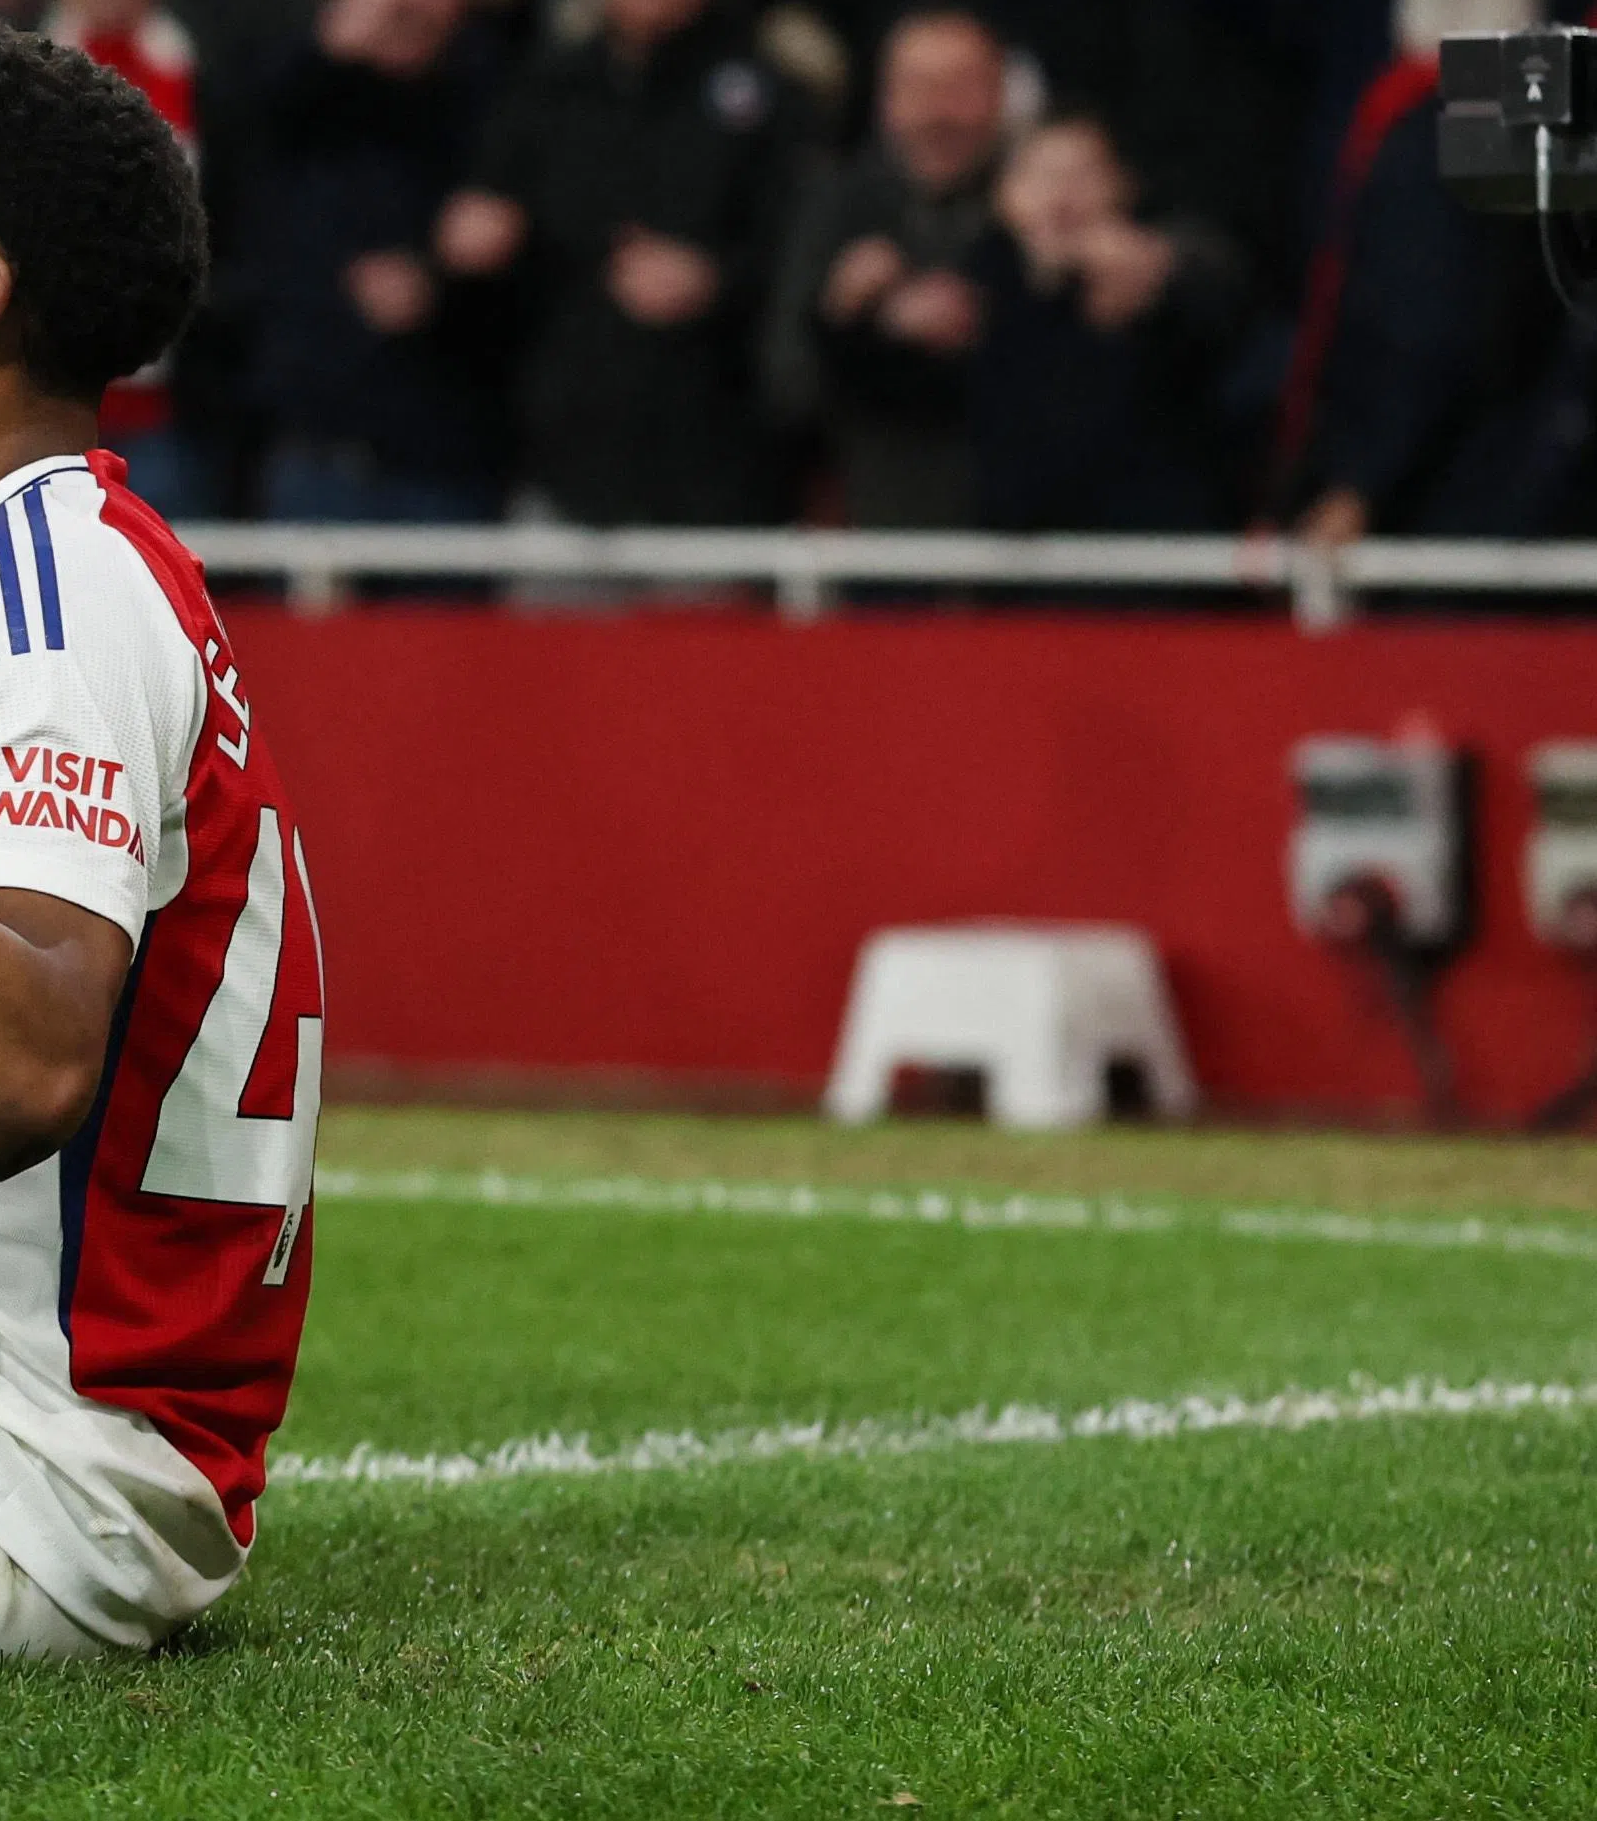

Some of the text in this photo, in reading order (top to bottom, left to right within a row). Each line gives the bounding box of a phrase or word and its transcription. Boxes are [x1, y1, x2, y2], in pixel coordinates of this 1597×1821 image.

[202, 587, 251, 772] LE
[1, 746, 125, 801] VISIT
[139, 805, 324, 1287] 4
